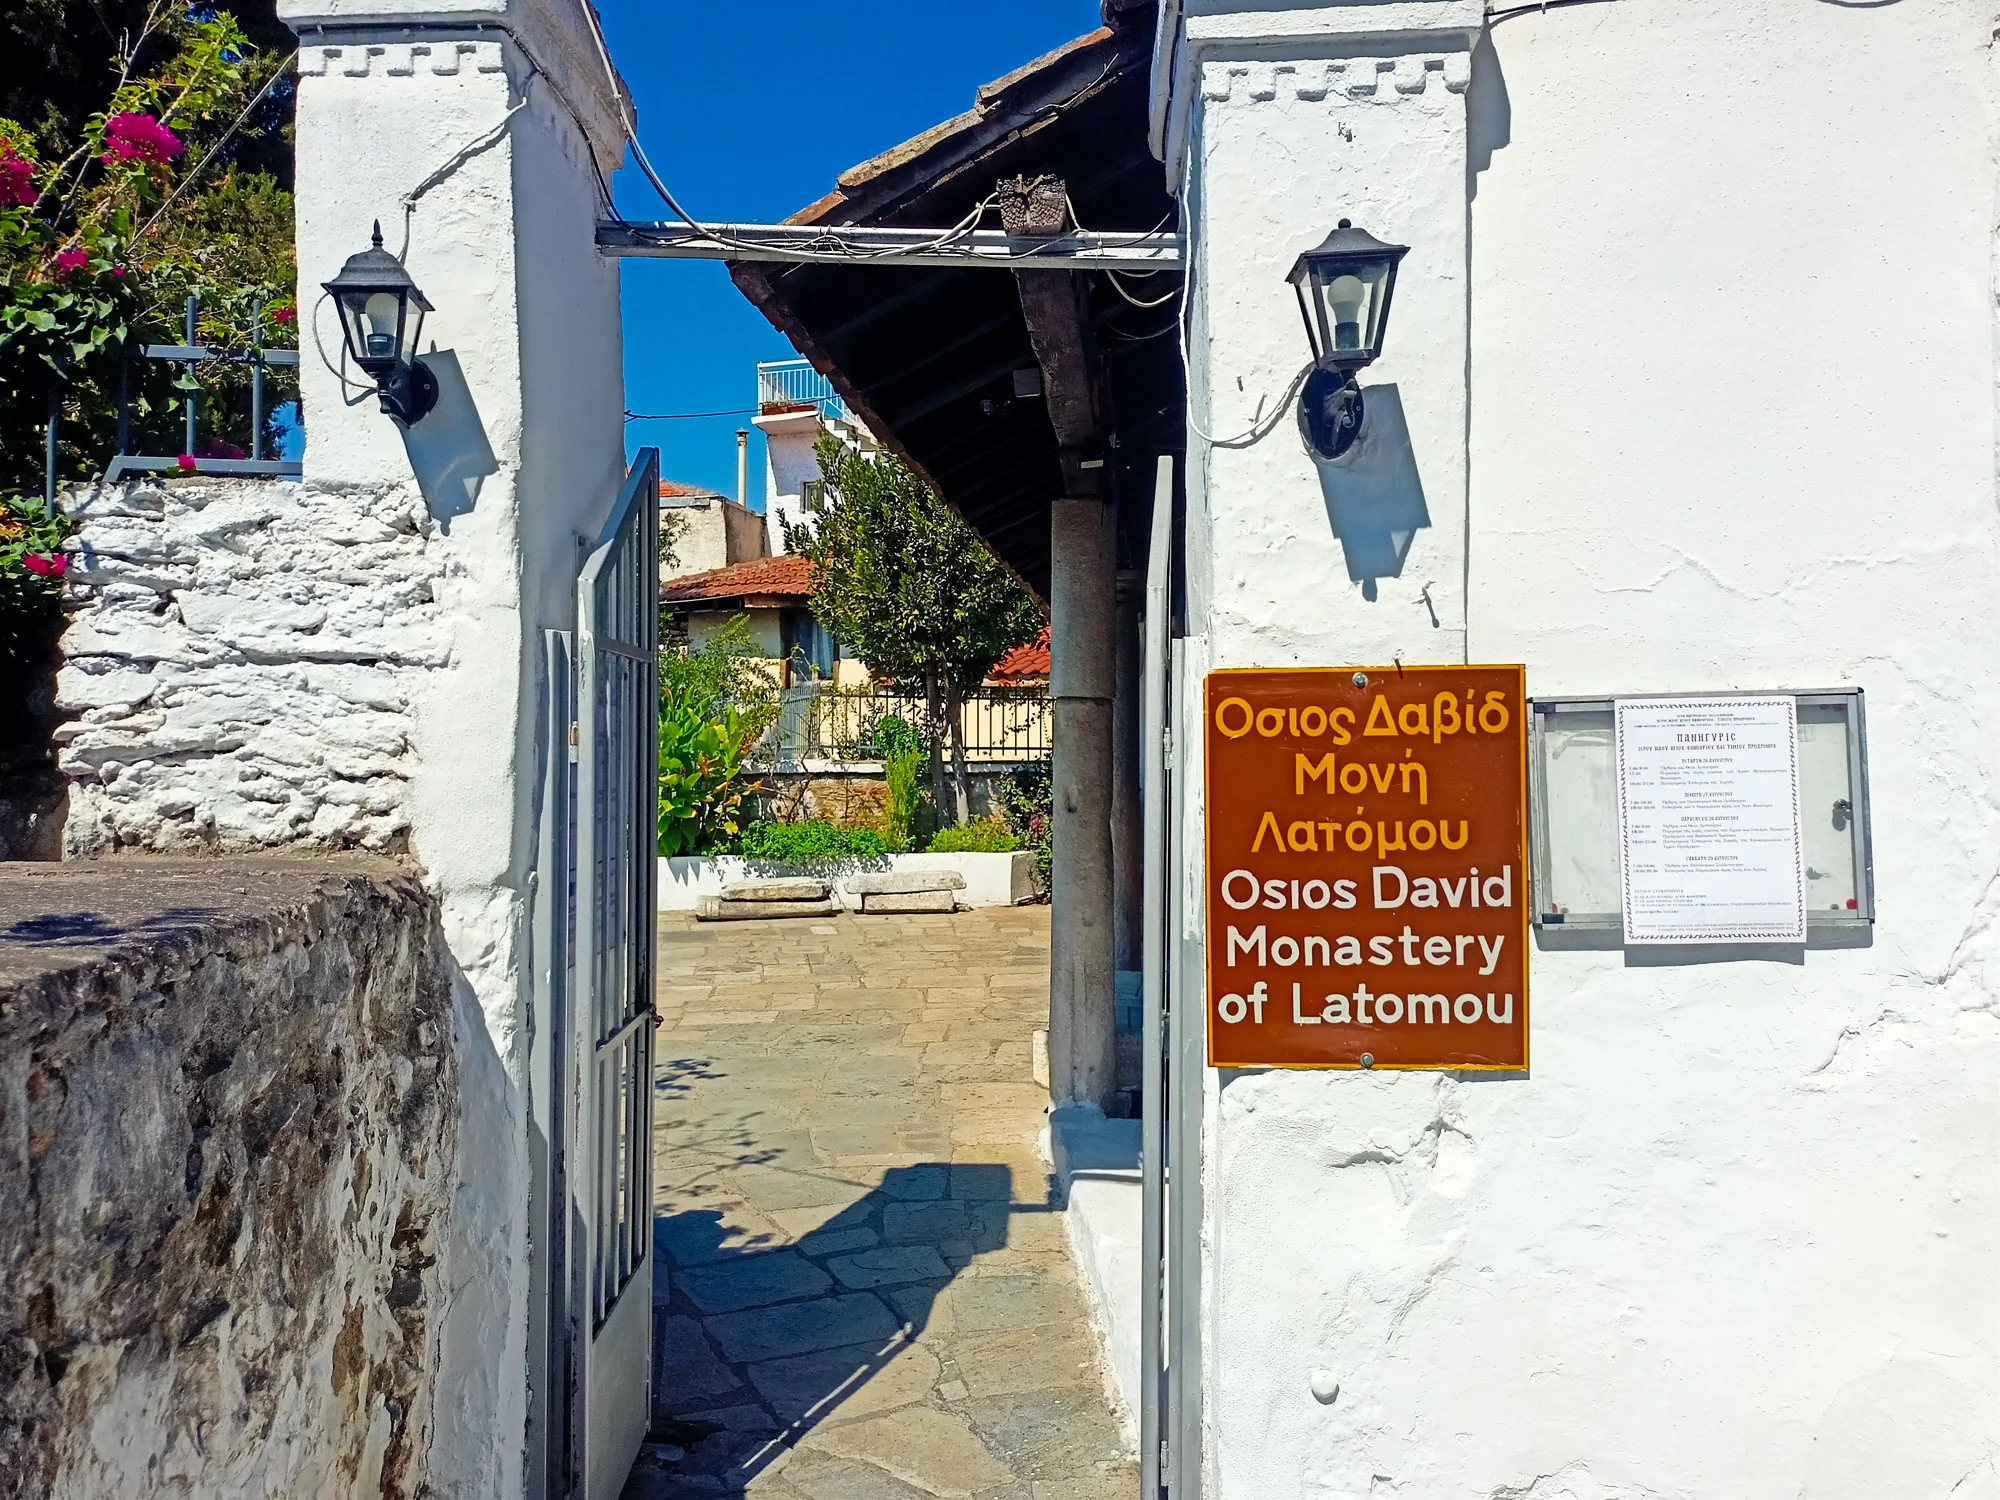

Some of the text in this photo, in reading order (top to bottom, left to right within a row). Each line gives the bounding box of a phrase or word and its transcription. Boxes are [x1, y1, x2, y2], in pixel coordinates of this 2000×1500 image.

[1215, 688, 1510, 745] Οσιος Δαβίδ
[1295, 748, 1428, 805] Μονή
[1250, 806, 1470, 860] Λατόμου
[1372, 864, 1513, 909] David
[1227, 924, 1506, 976] Monastery
[1217, 980, 1514, 1025] of Latomou
